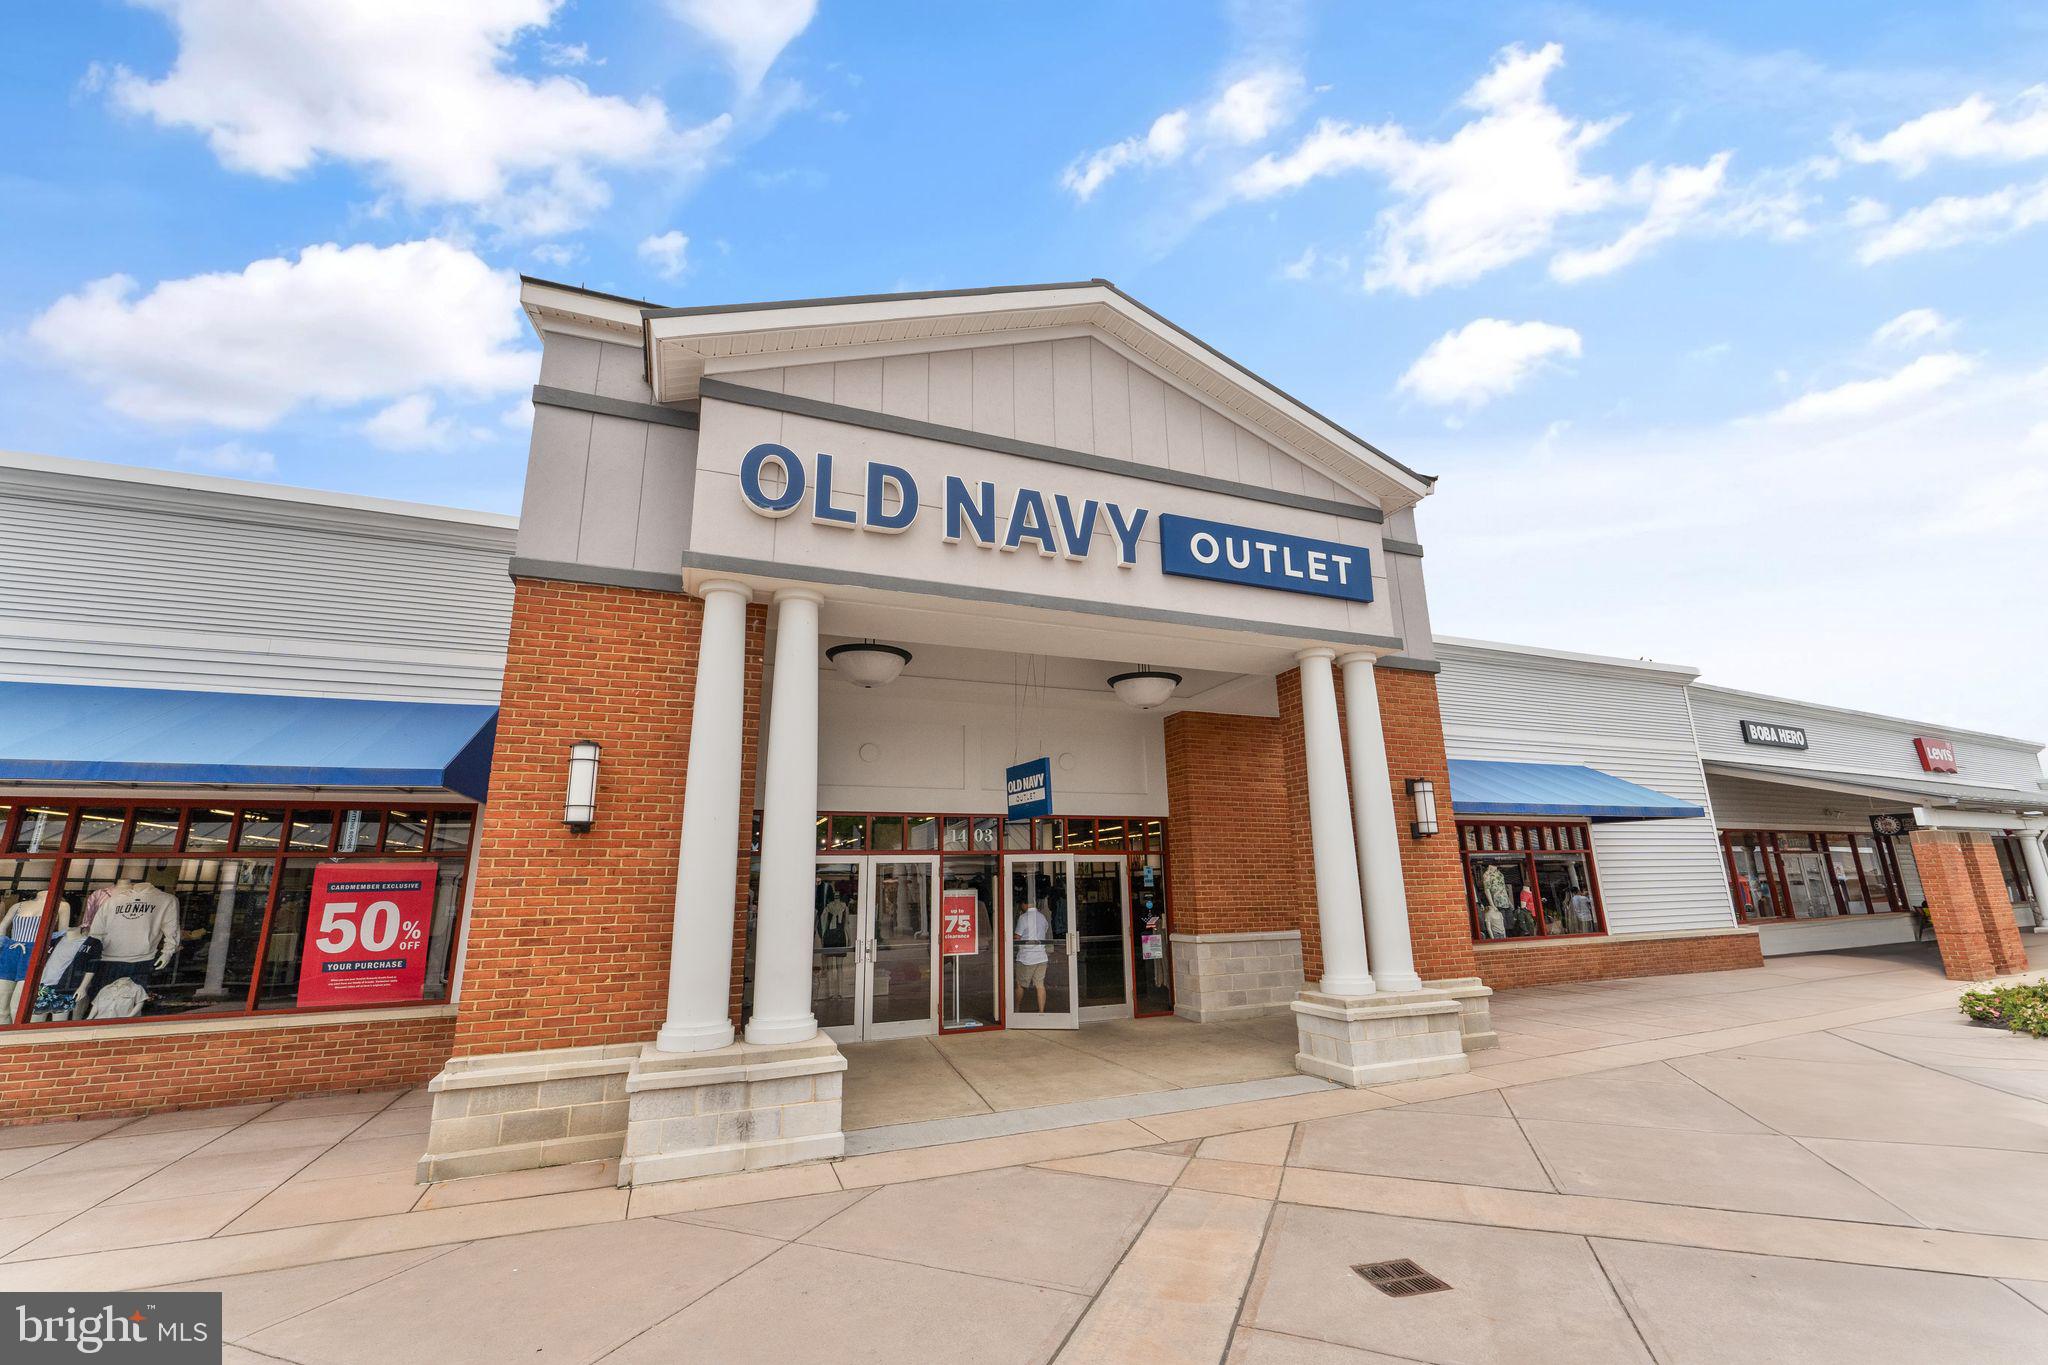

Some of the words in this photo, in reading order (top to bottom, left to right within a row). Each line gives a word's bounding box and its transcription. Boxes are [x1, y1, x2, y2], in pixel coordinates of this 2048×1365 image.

[739, 442, 920, 535] OLD
[941, 473, 1150, 569] NAVY
[1190, 532, 1353, 586] OUTLET
[1749, 724, 1779, 742] BOBA
[1778, 728, 1805, 746] HERO
[1007, 778, 1023, 794] OLD
[1023, 773, 1045, 790] NAVY
[330, 883, 380, 891] CARDMEMBER
[382, 882, 419, 890] EXCLUSIVE
[115, 903, 133, 914] OLD
[133, 904, 156, 914] NAVY
[399, 941, 421, 951] OFF
[327, 962, 352, 971] YOUR
[354, 960, 404, 970] PURCHASE
